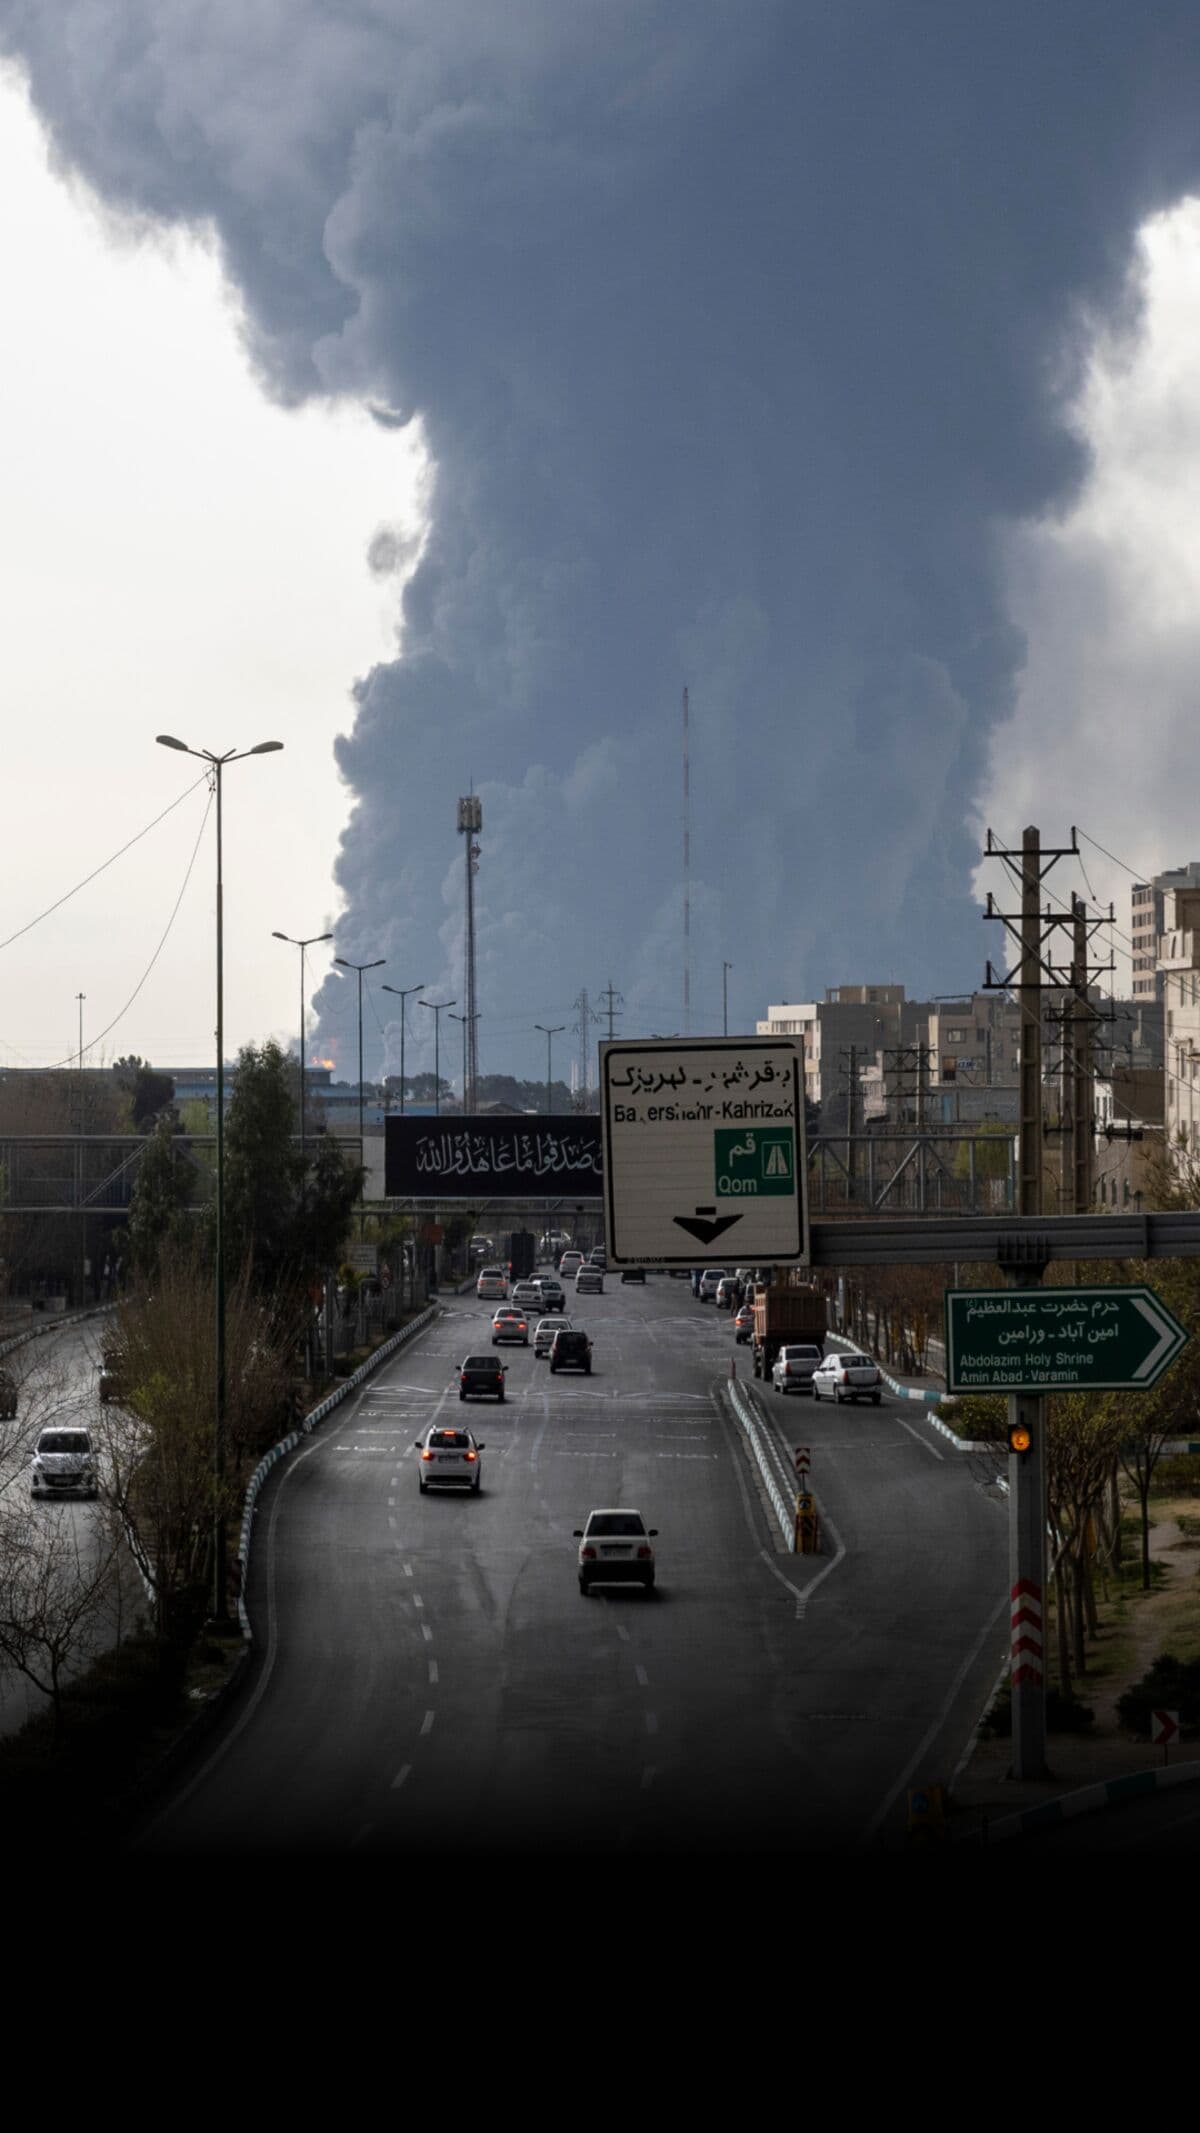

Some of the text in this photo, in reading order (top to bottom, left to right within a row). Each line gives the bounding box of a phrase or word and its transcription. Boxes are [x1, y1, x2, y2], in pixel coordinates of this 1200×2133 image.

[729, 1132, 757, 1168] قم
[718, 1175, 757, 1194] Qom
[1040, 1299, 1088, 1317] حضرت
[1091, 1301, 1120, 1318] حرم
[998, 1324, 1045, 1345] ورامین
[1058, 1321, 1086, 1342] آباد
[1088, 1323, 1118, 1343] امین
[960, 1352, 1094, 1367] Abdolazim Holy Shrine
[960, 1371, 989, 1383] Amin
